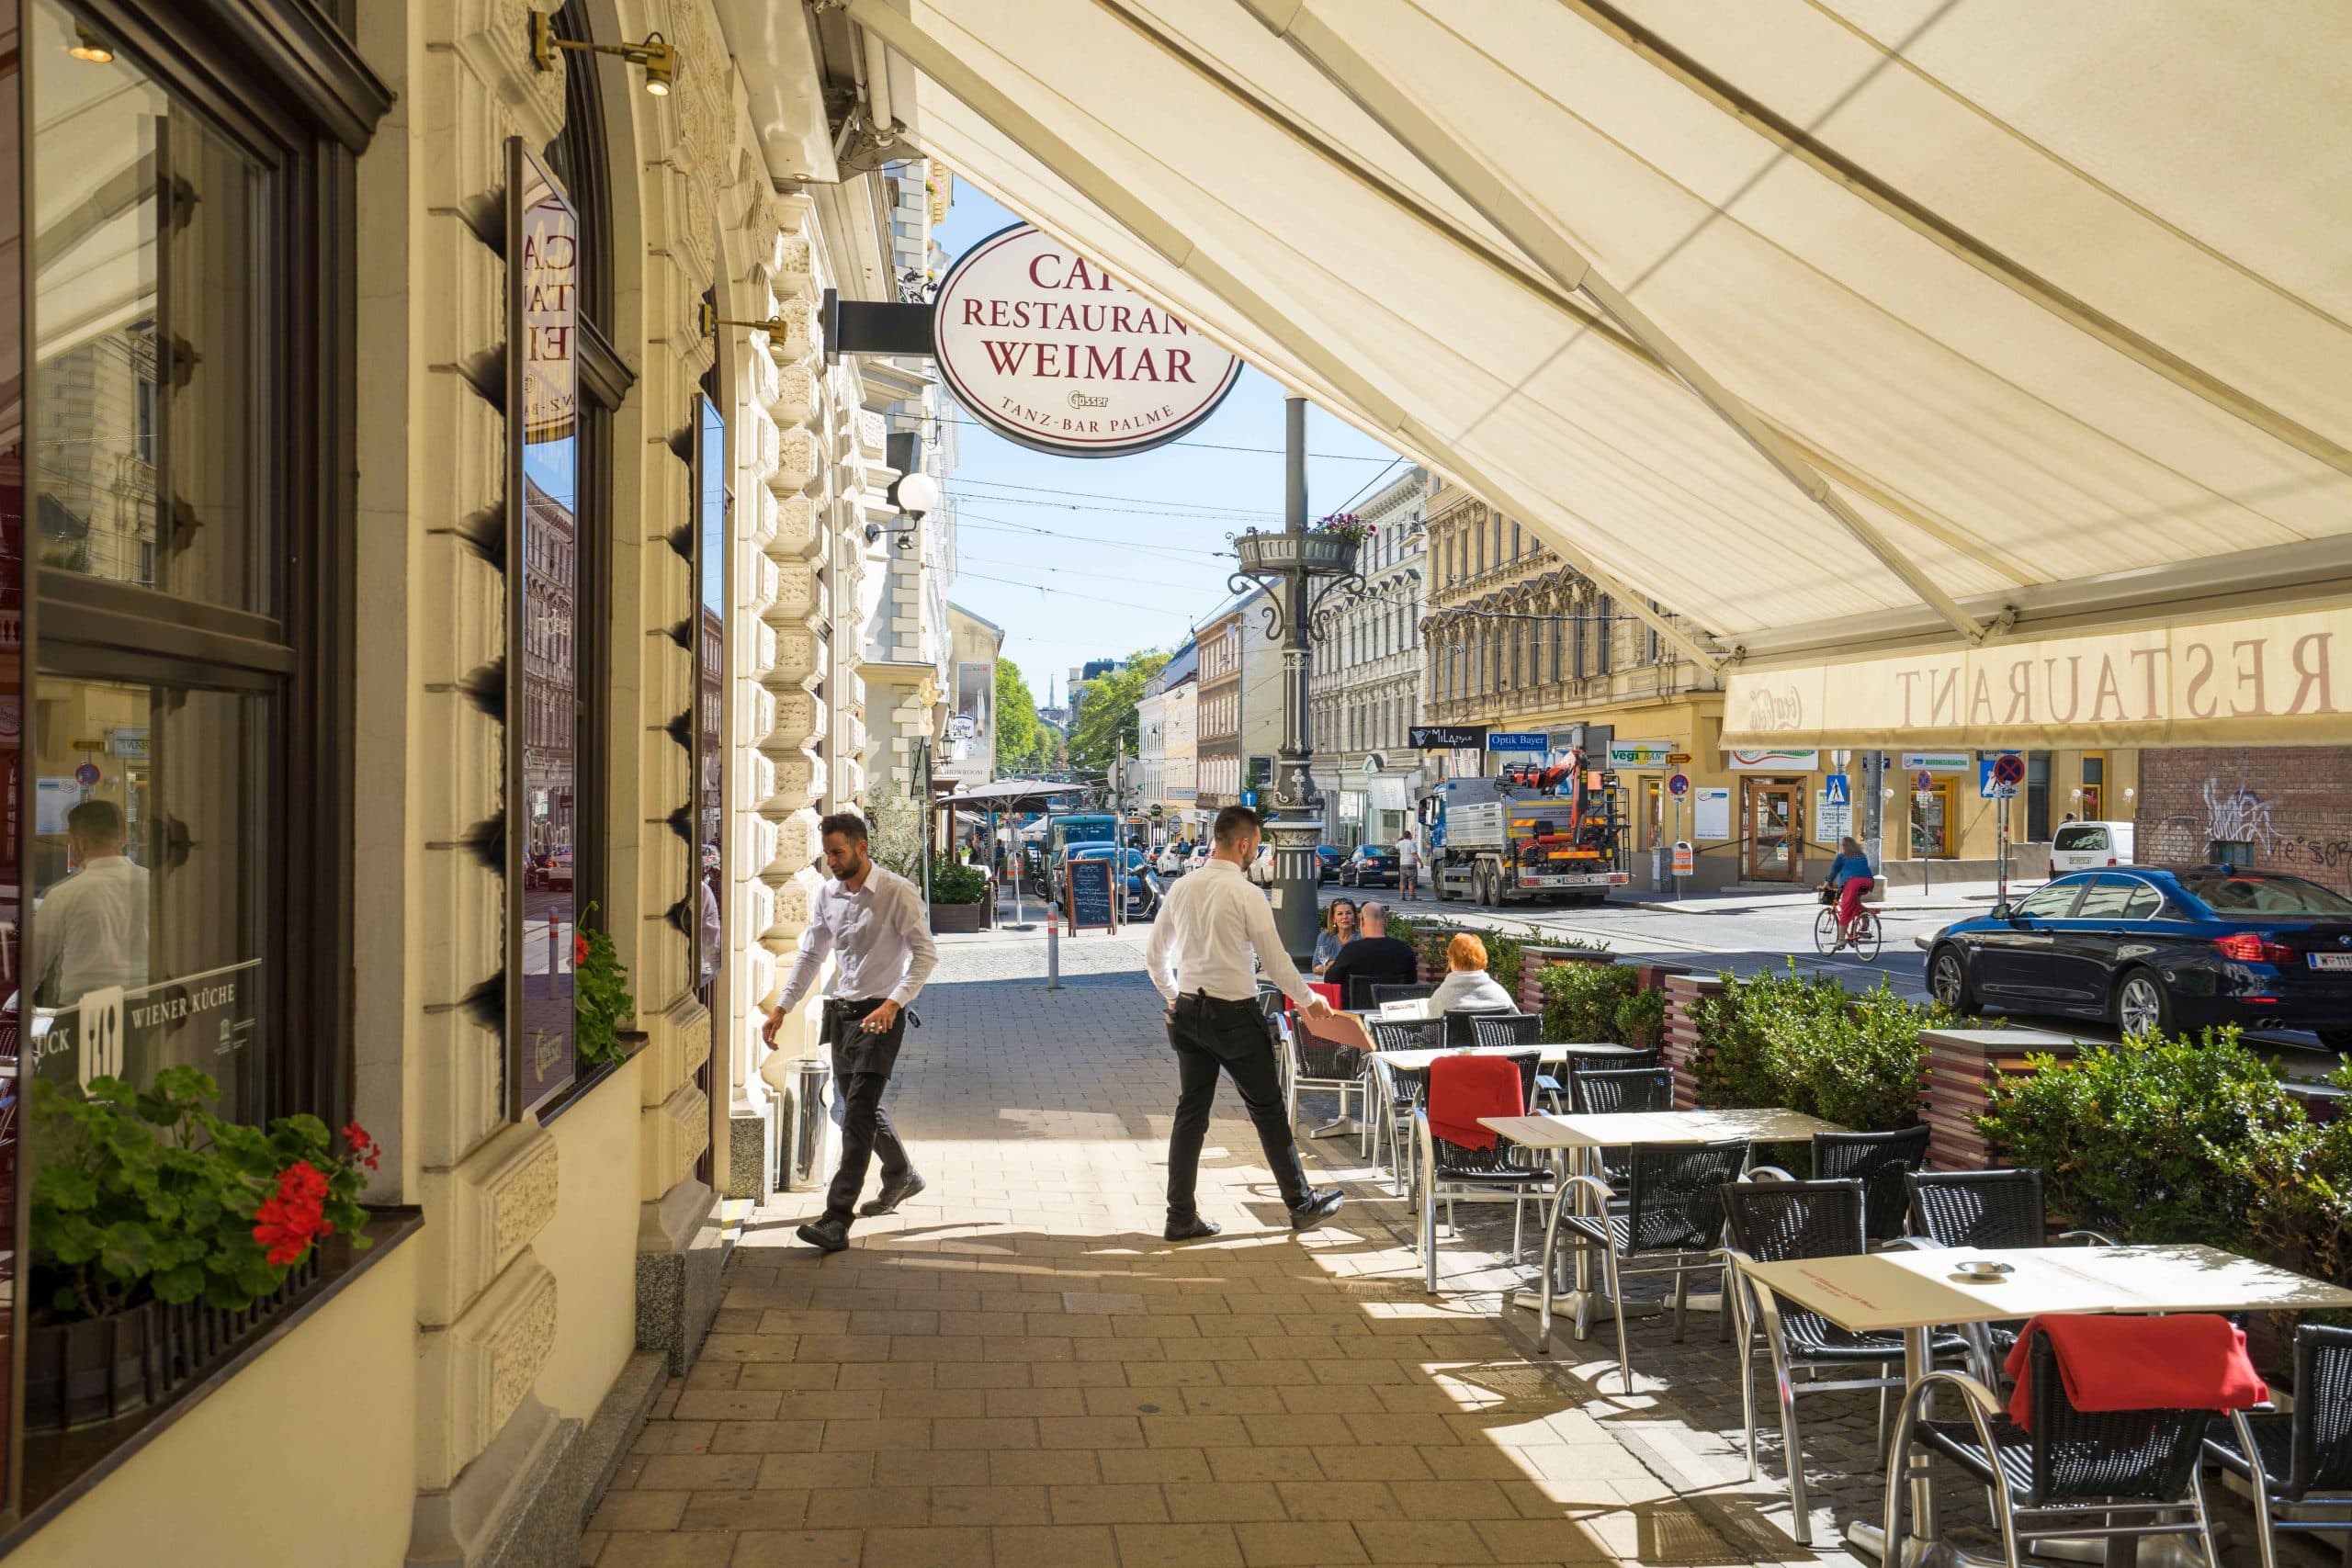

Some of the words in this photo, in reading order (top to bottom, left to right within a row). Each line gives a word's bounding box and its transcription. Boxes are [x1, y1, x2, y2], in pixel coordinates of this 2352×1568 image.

[962, 298, 1203, 336] RESTAURAN
[981, 340, 1197, 384] WEIMAR
[1000, 395, 1100, 434] TANZ-BAR
[1110, 404, 1174, 432] PALME
[1068, 390, 1109, 409] Gösser
[1491, 736, 1517, 746] Optik
[1520, 736, 1544, 746] Bayer
[1611, 750, 1640, 762] Vegi
[131, 998, 187, 1030] WIENER
[192, 984, 235, 1013] KÜCHE
